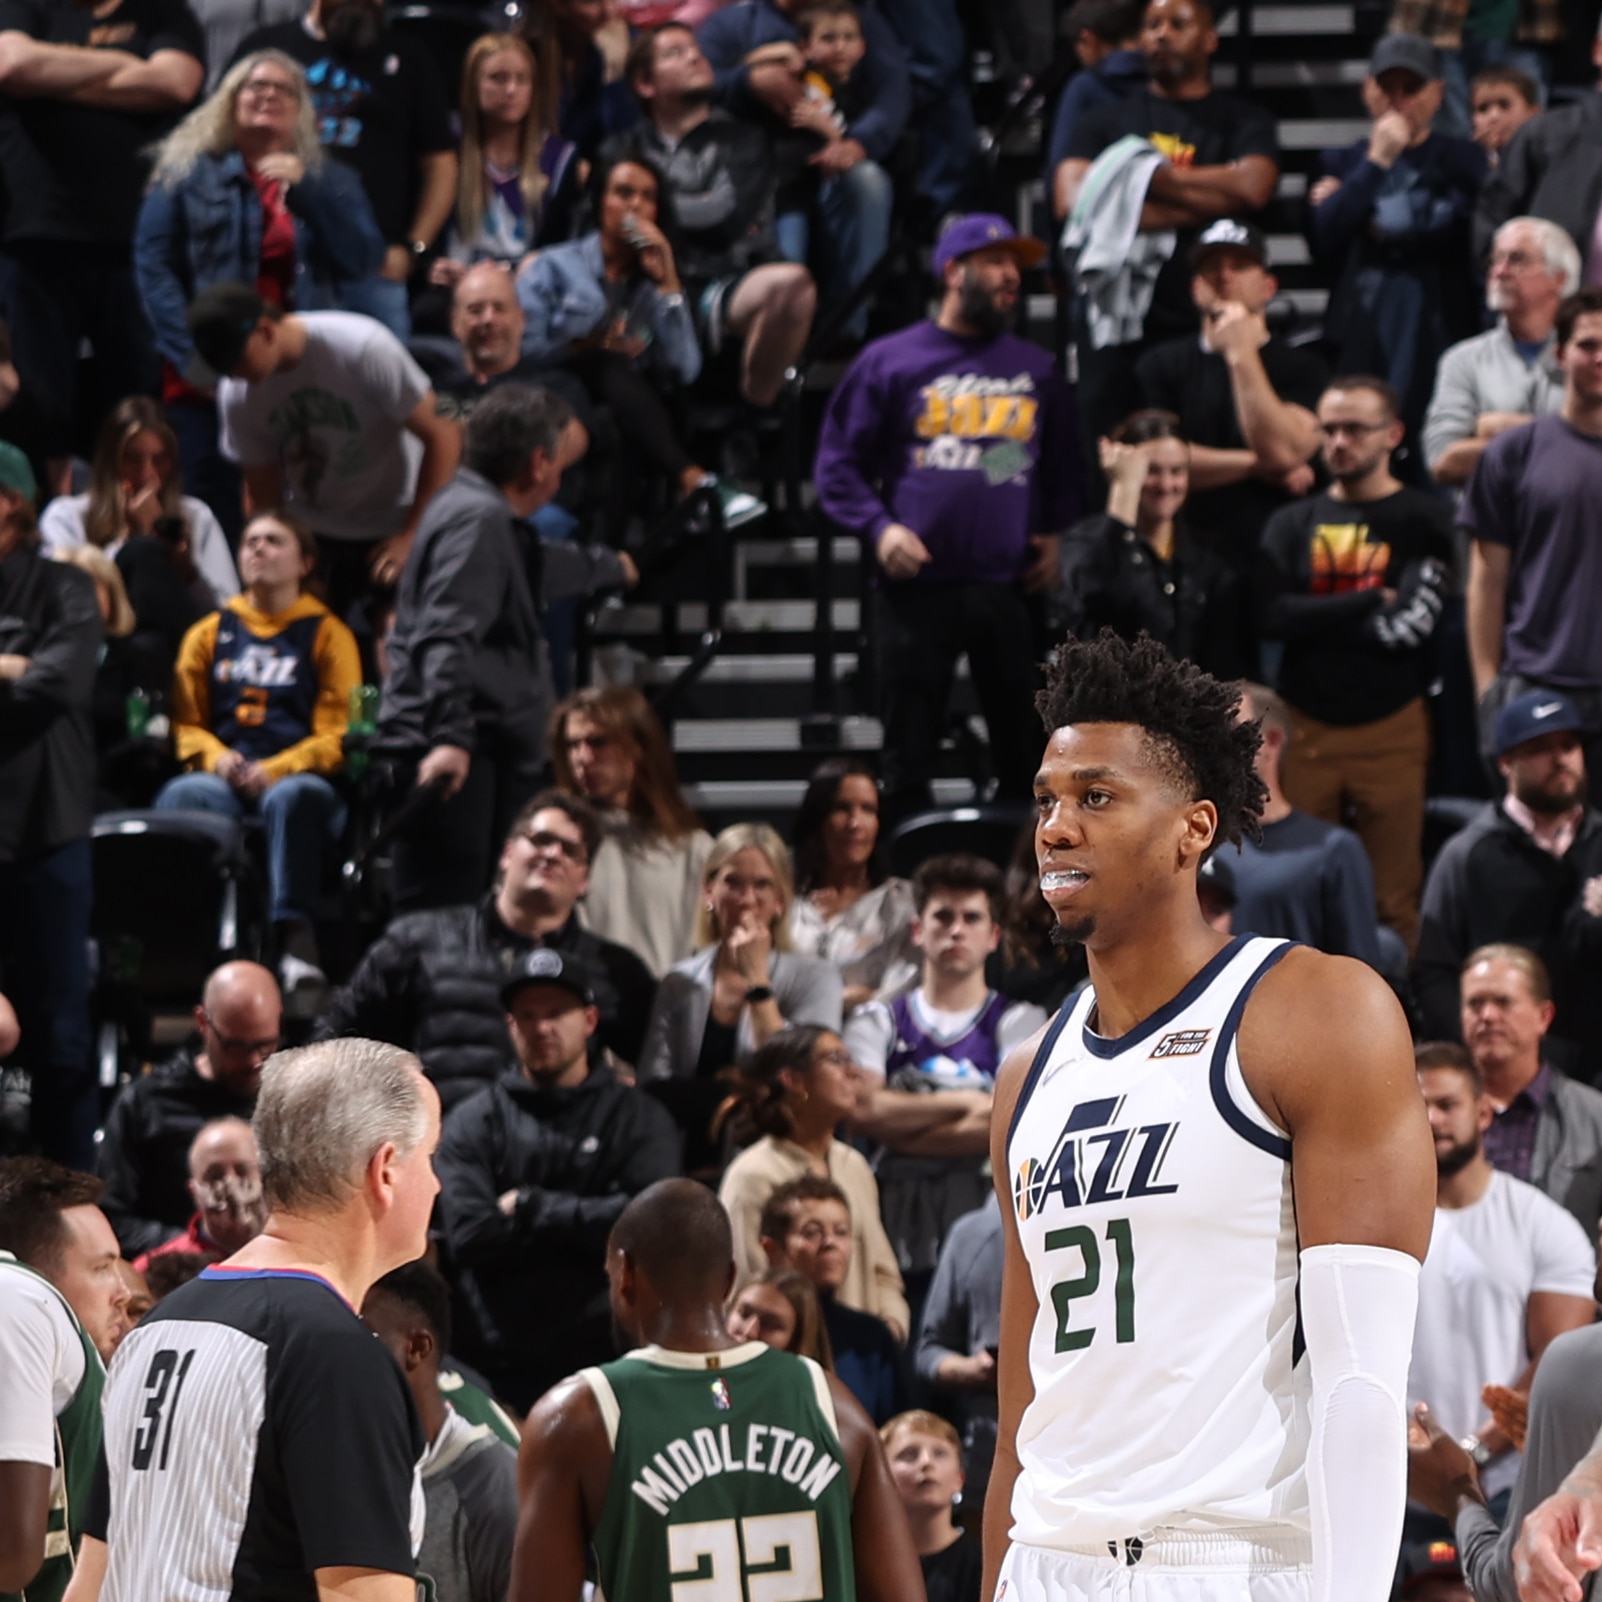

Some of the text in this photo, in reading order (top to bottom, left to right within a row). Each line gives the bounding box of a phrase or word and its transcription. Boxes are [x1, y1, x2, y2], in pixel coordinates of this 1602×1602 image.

[1153, 1034, 1177, 1057] 5
[1169, 1041, 1206, 1055] FIGHT
[1015, 1093, 1181, 1222] JAZZ
[1044, 1217, 1136, 1355] 21
[131, 1348, 196, 1471] 31
[631, 1422, 842, 1517] MIDDLETON
